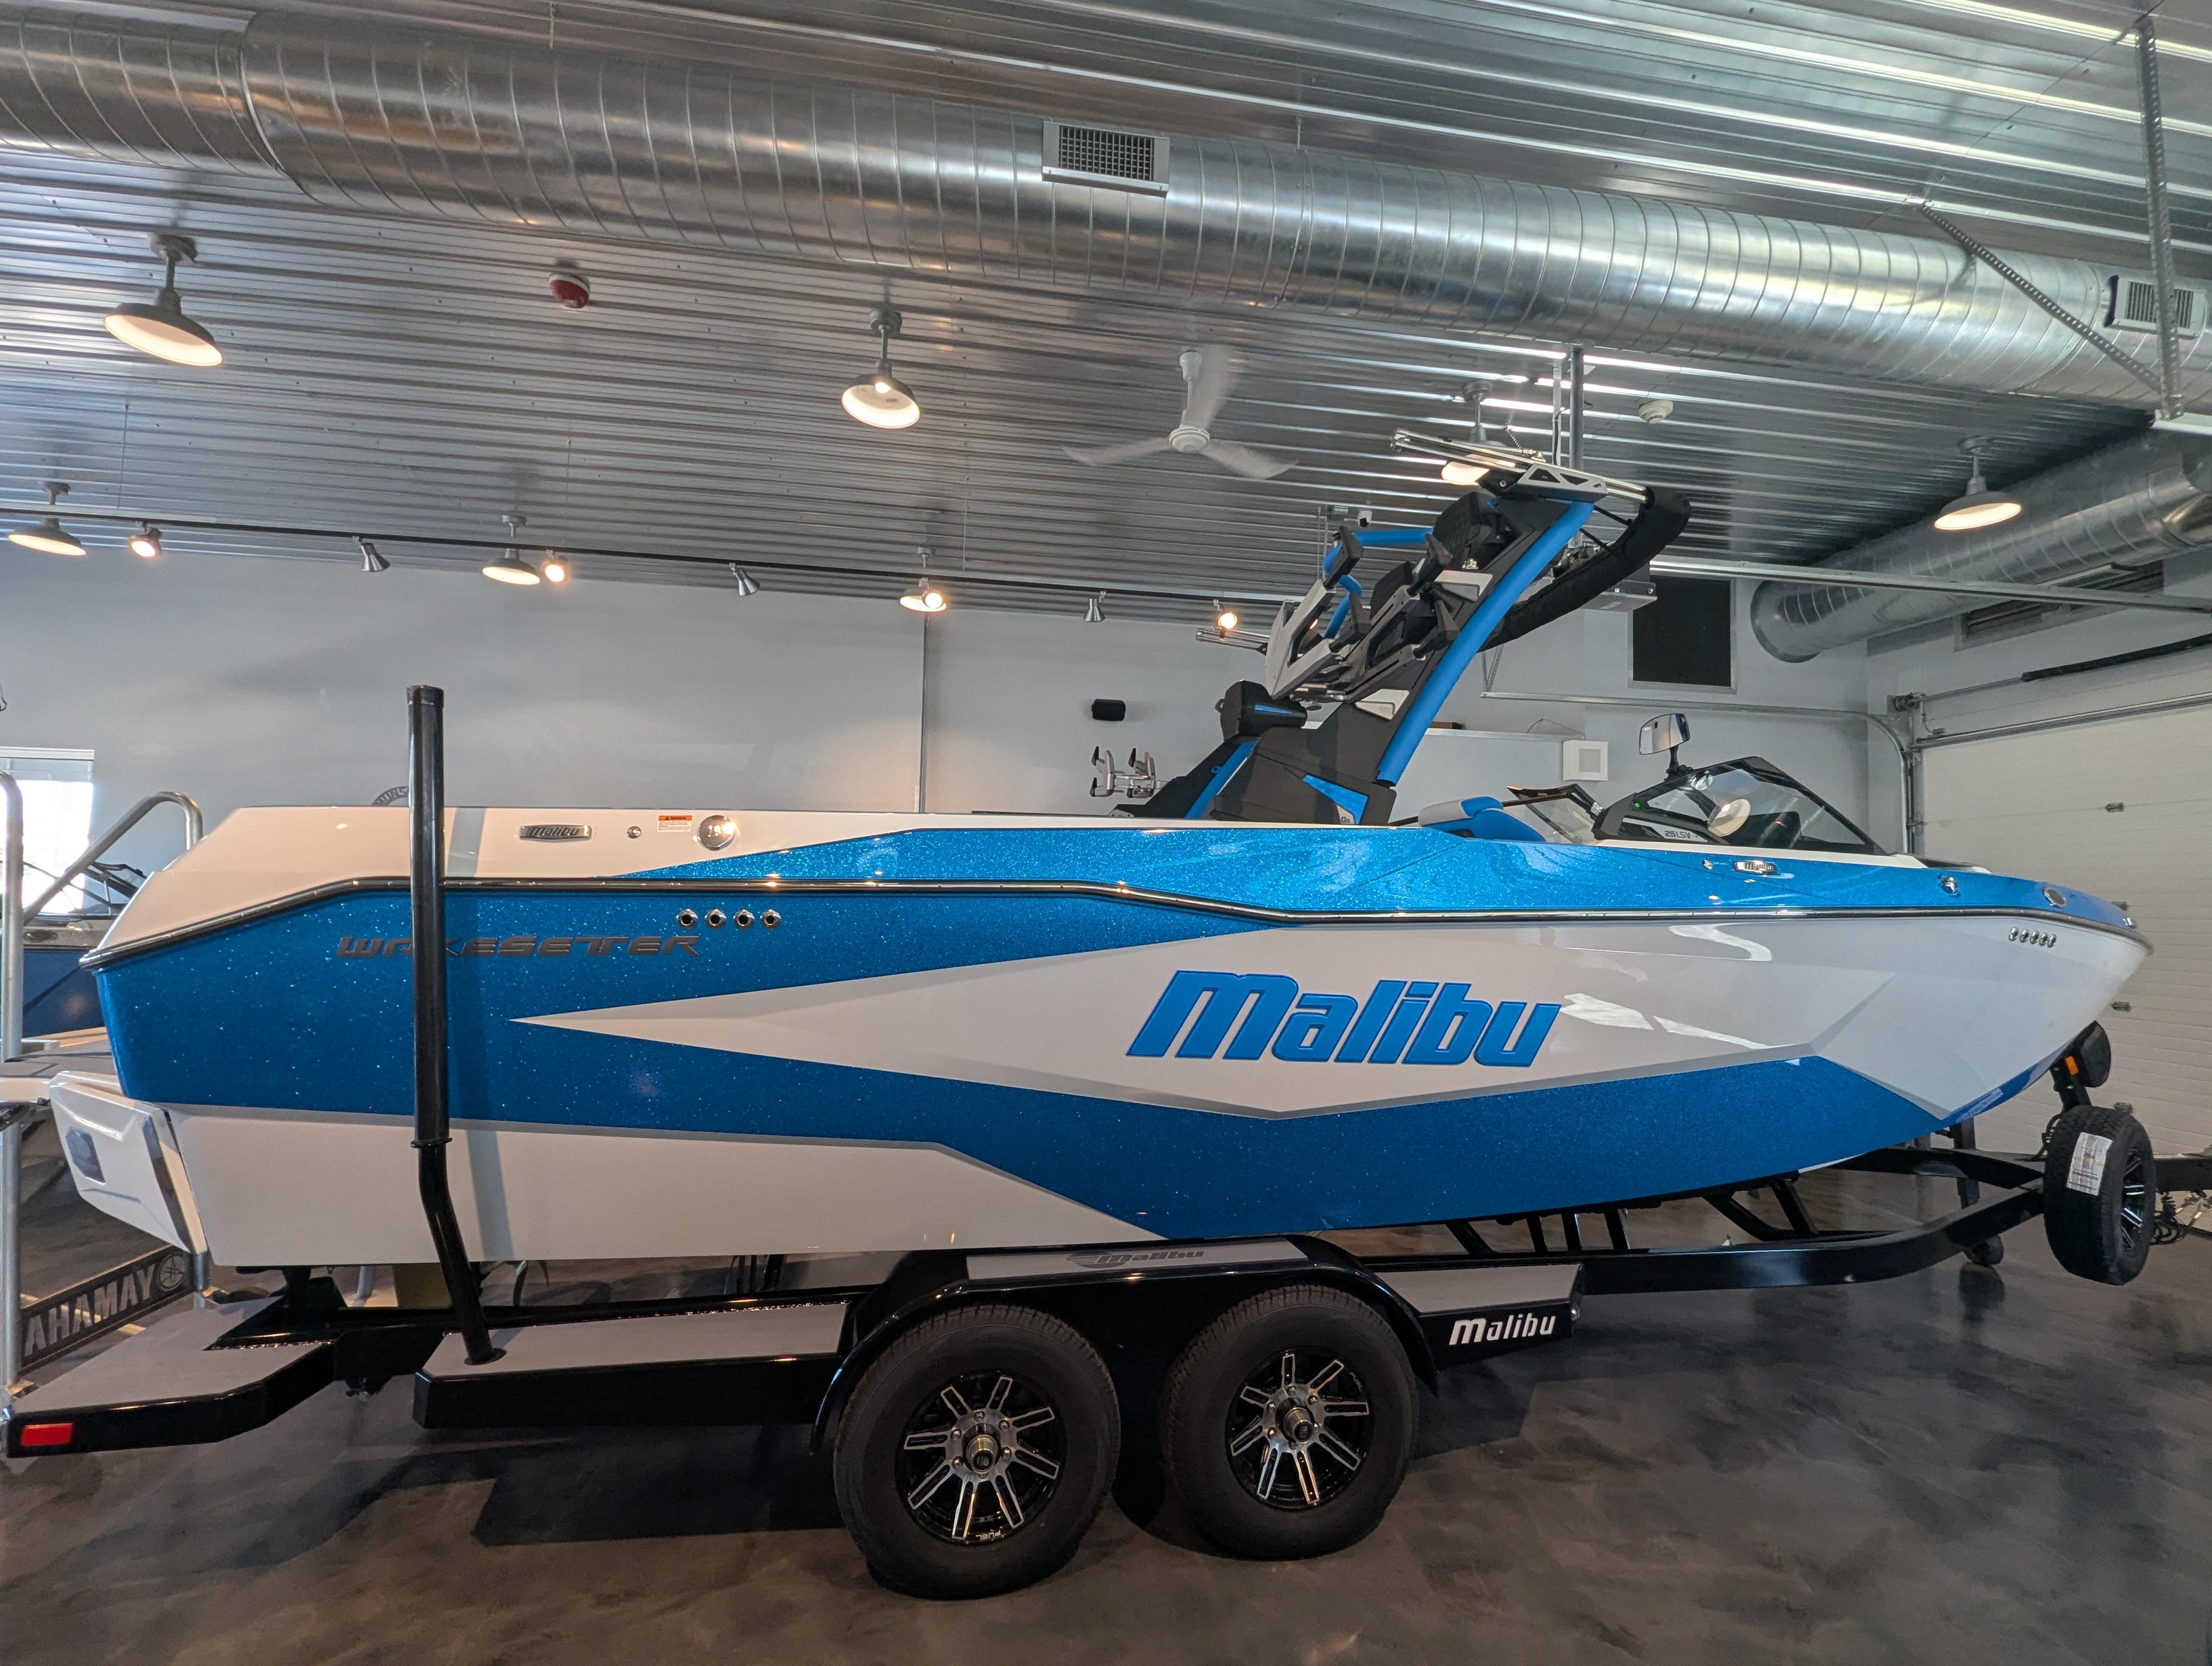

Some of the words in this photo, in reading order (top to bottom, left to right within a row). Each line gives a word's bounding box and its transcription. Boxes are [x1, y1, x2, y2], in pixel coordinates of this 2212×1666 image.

[1126, 970, 1562, 1067] Malibu
[1449, 1312, 1556, 1345] Malibu
[976, 1530, 1001, 1541] FUEL
